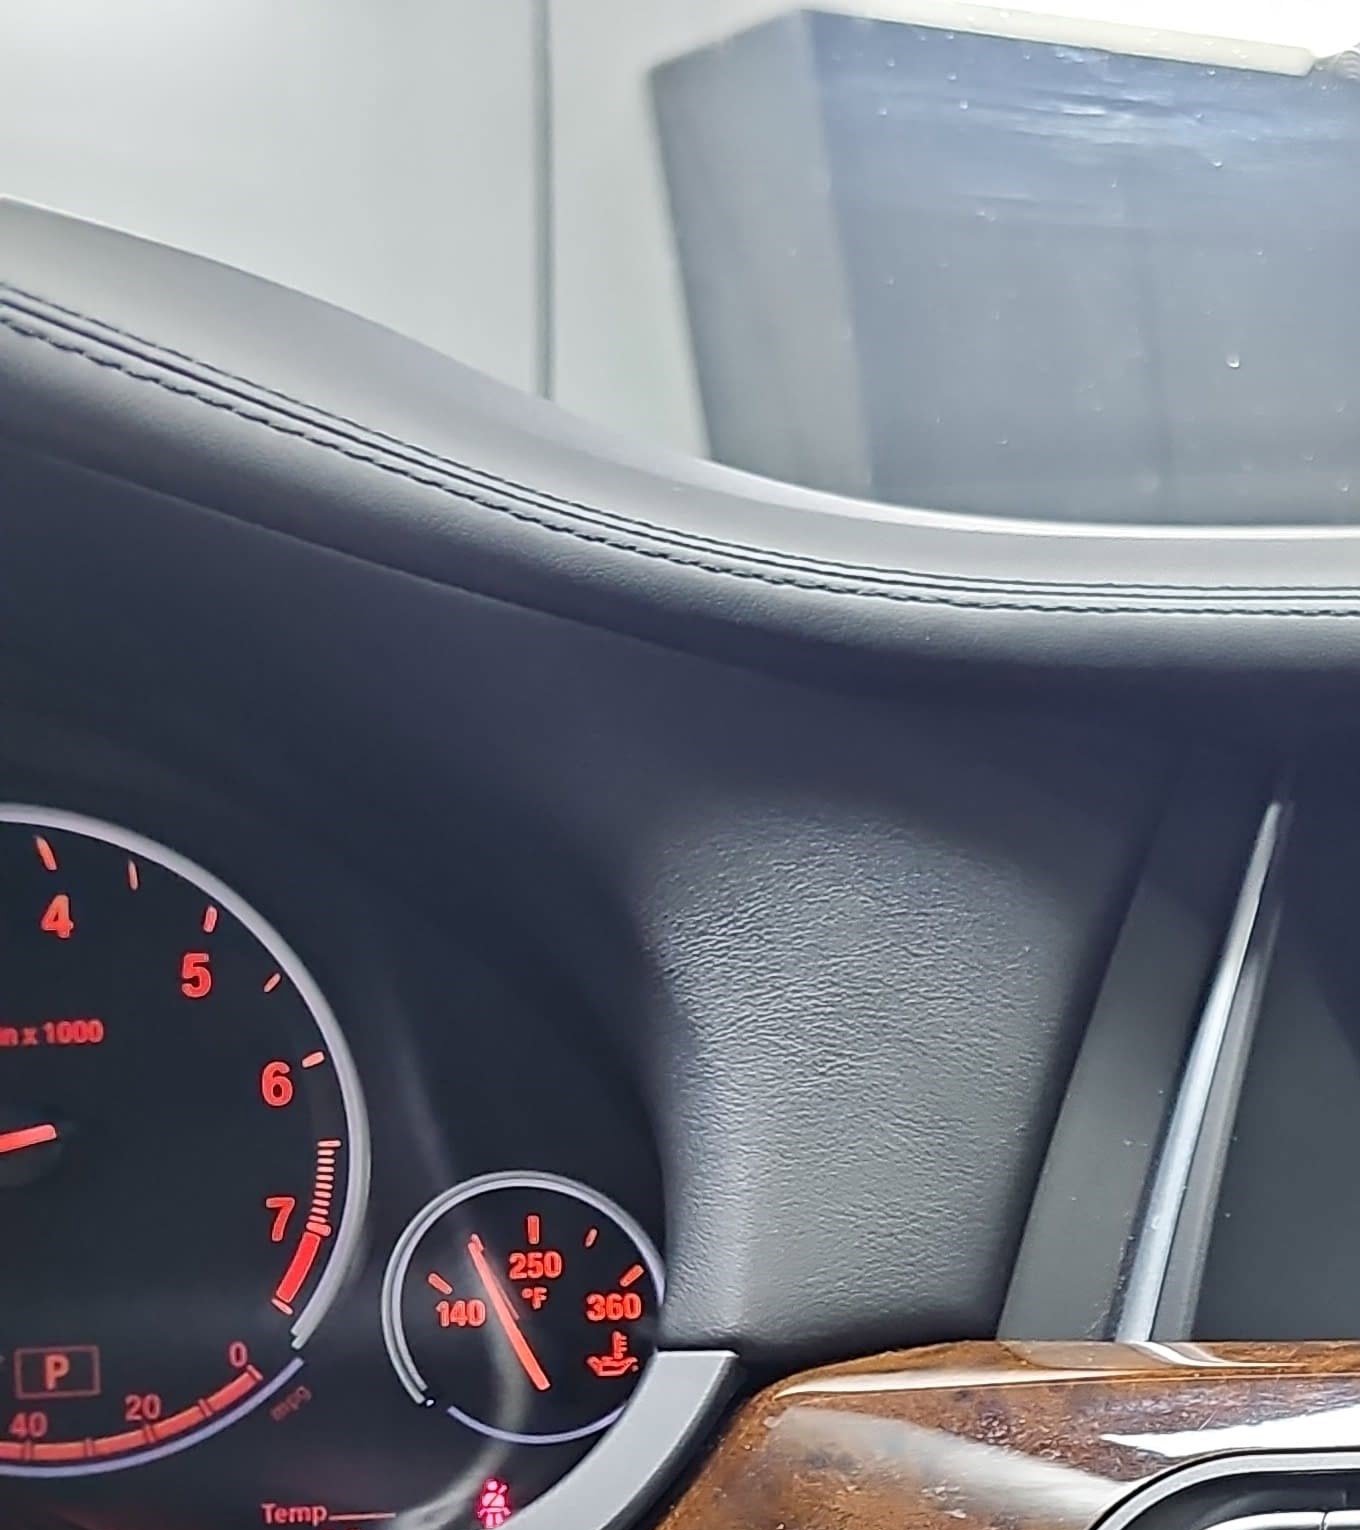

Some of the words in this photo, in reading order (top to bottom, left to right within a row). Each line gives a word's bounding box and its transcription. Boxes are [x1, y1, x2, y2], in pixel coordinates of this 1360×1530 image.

[41, 894, 74, 938] 4
[181, 952, 212, 998] 5
[43, 1019, 104, 1044] 1000
[261, 1061, 294, 1106] 6
[265, 1196, 296, 1242] 7
[509, 1251, 563, 1280] 250
[436, 1300, 486, 1327] 140
[586, 1293, 642, 1321] 360
[228, 1341, 249, 1367] 0
[43, 1353, 71, 1391] P
[124, 1393, 162, 1422] 20
[9, 1411, 48, 1438] 40
[261, 1503, 328, 1527] Temp
